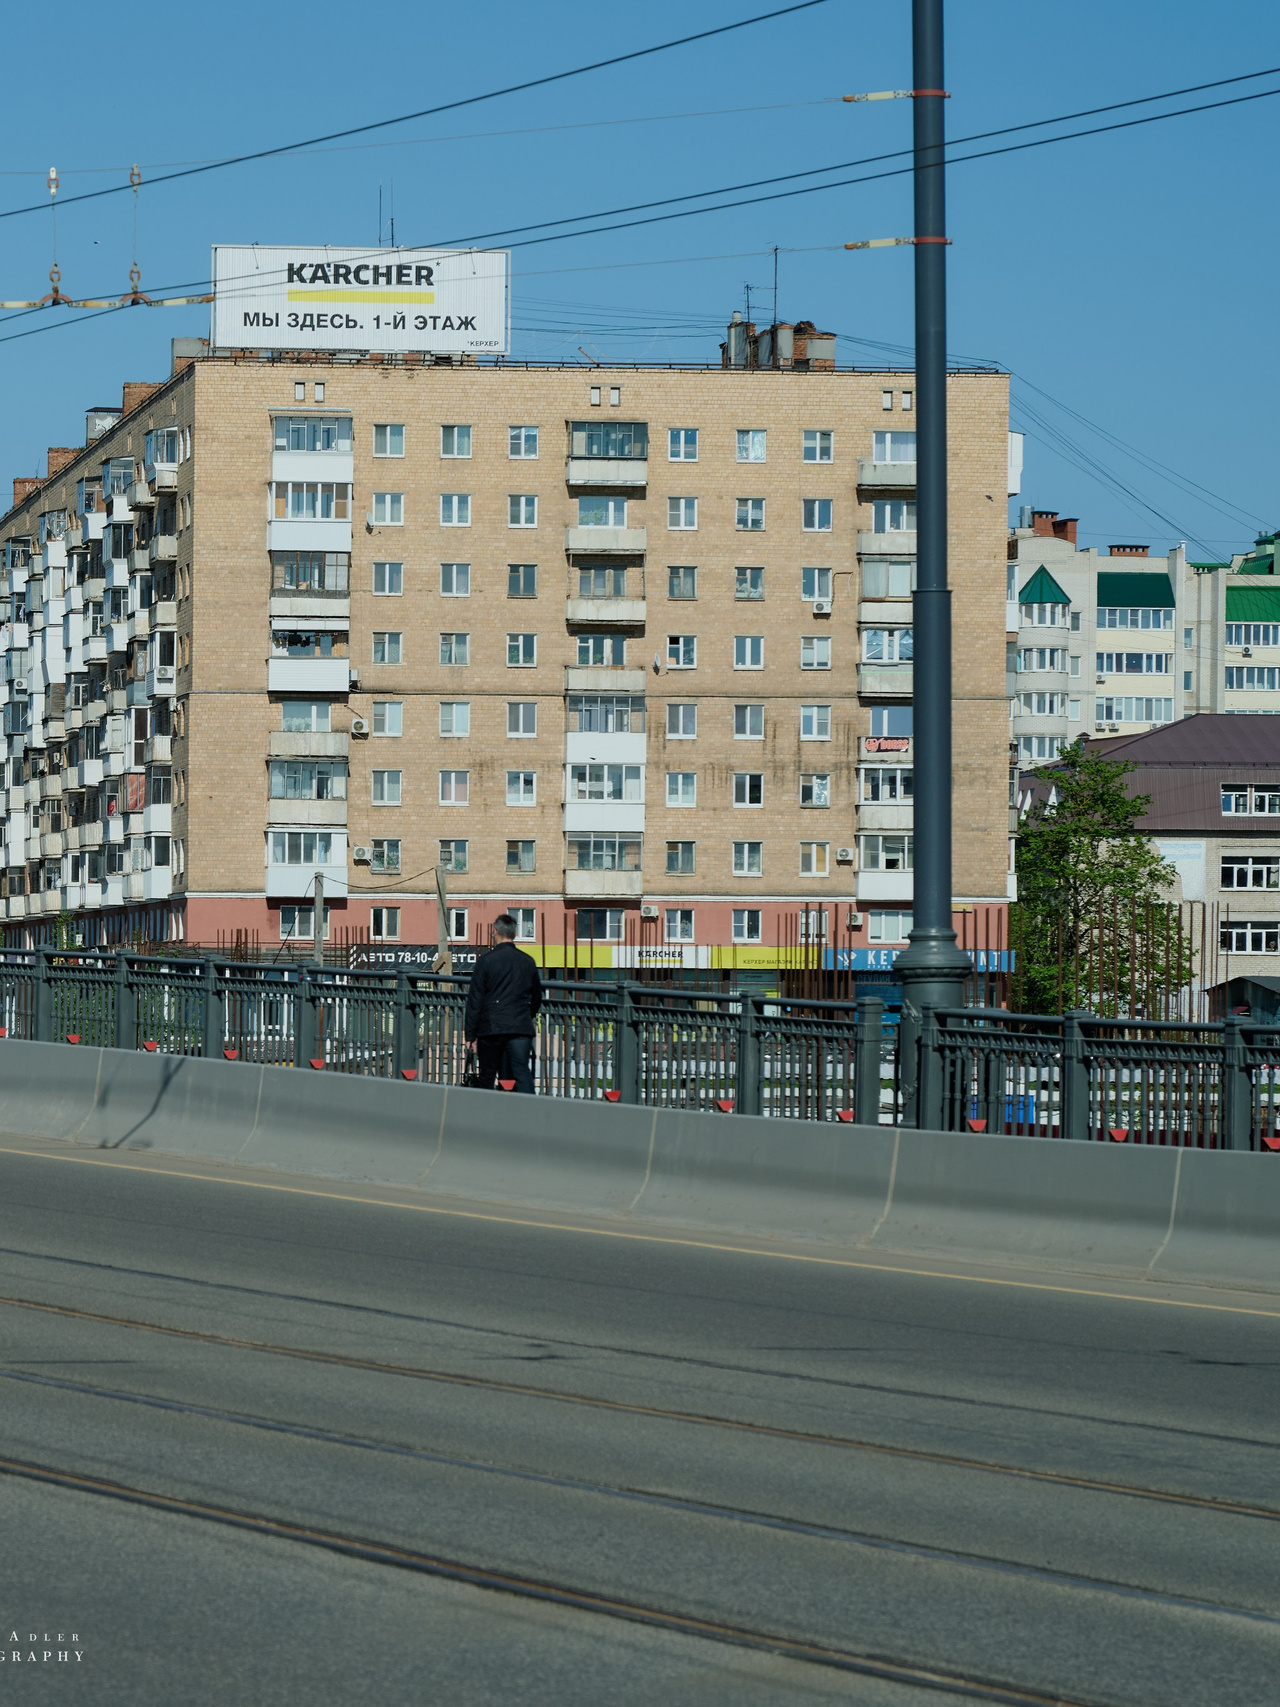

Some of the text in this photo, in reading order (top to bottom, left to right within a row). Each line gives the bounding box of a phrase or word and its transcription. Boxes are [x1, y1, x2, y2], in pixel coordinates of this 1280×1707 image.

[243, 311, 477, 331] МЫ ЗДЕСЬ. 1-Й ЭТАЖ
